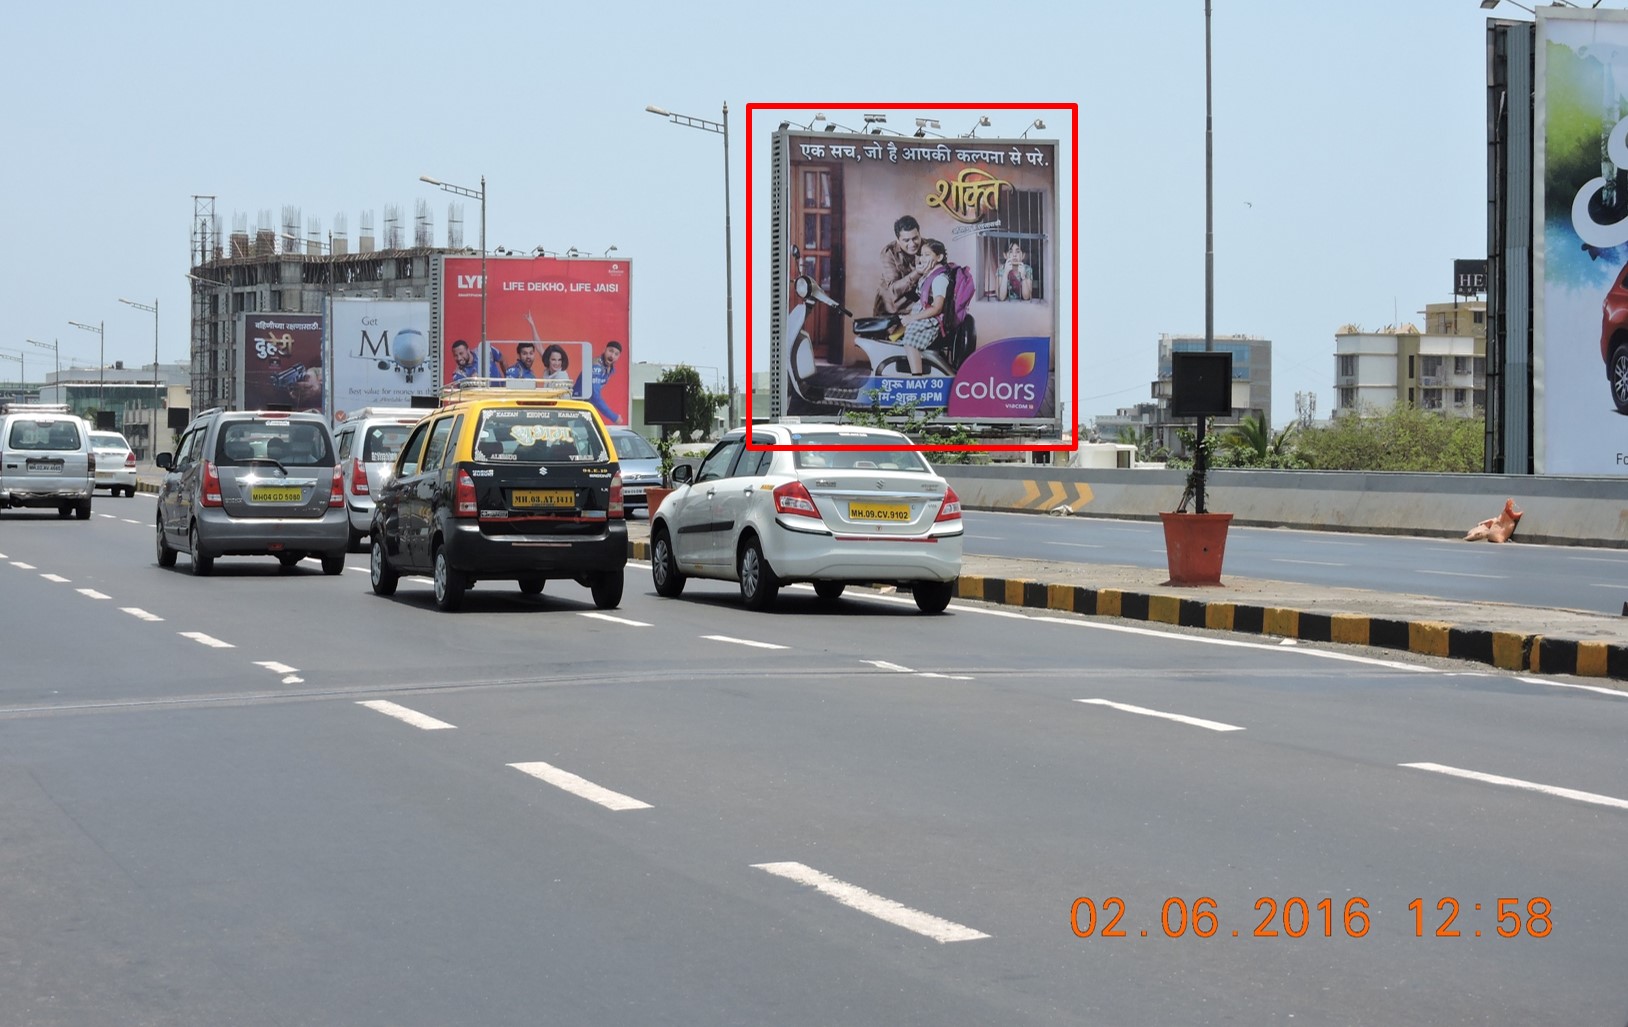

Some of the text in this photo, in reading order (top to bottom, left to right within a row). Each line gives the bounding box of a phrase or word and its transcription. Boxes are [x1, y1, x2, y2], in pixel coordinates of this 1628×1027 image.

[800, 141, 1049, 167] एक सच, जो है आपकी कल्पना से परे.
[926, 167, 1014, 224] शक्ति
[503, 281, 619, 293] LIFE DEKHO, LIFE JAISI
[361, 316, 378, 326] Get
[906, 379, 928, 389] MAY
[930, 379, 944, 389] 30
[955, 377, 1035, 401] colors
[382, 387, 391, 395] for
[851, 510, 909, 519] MH.09.CV.9102
